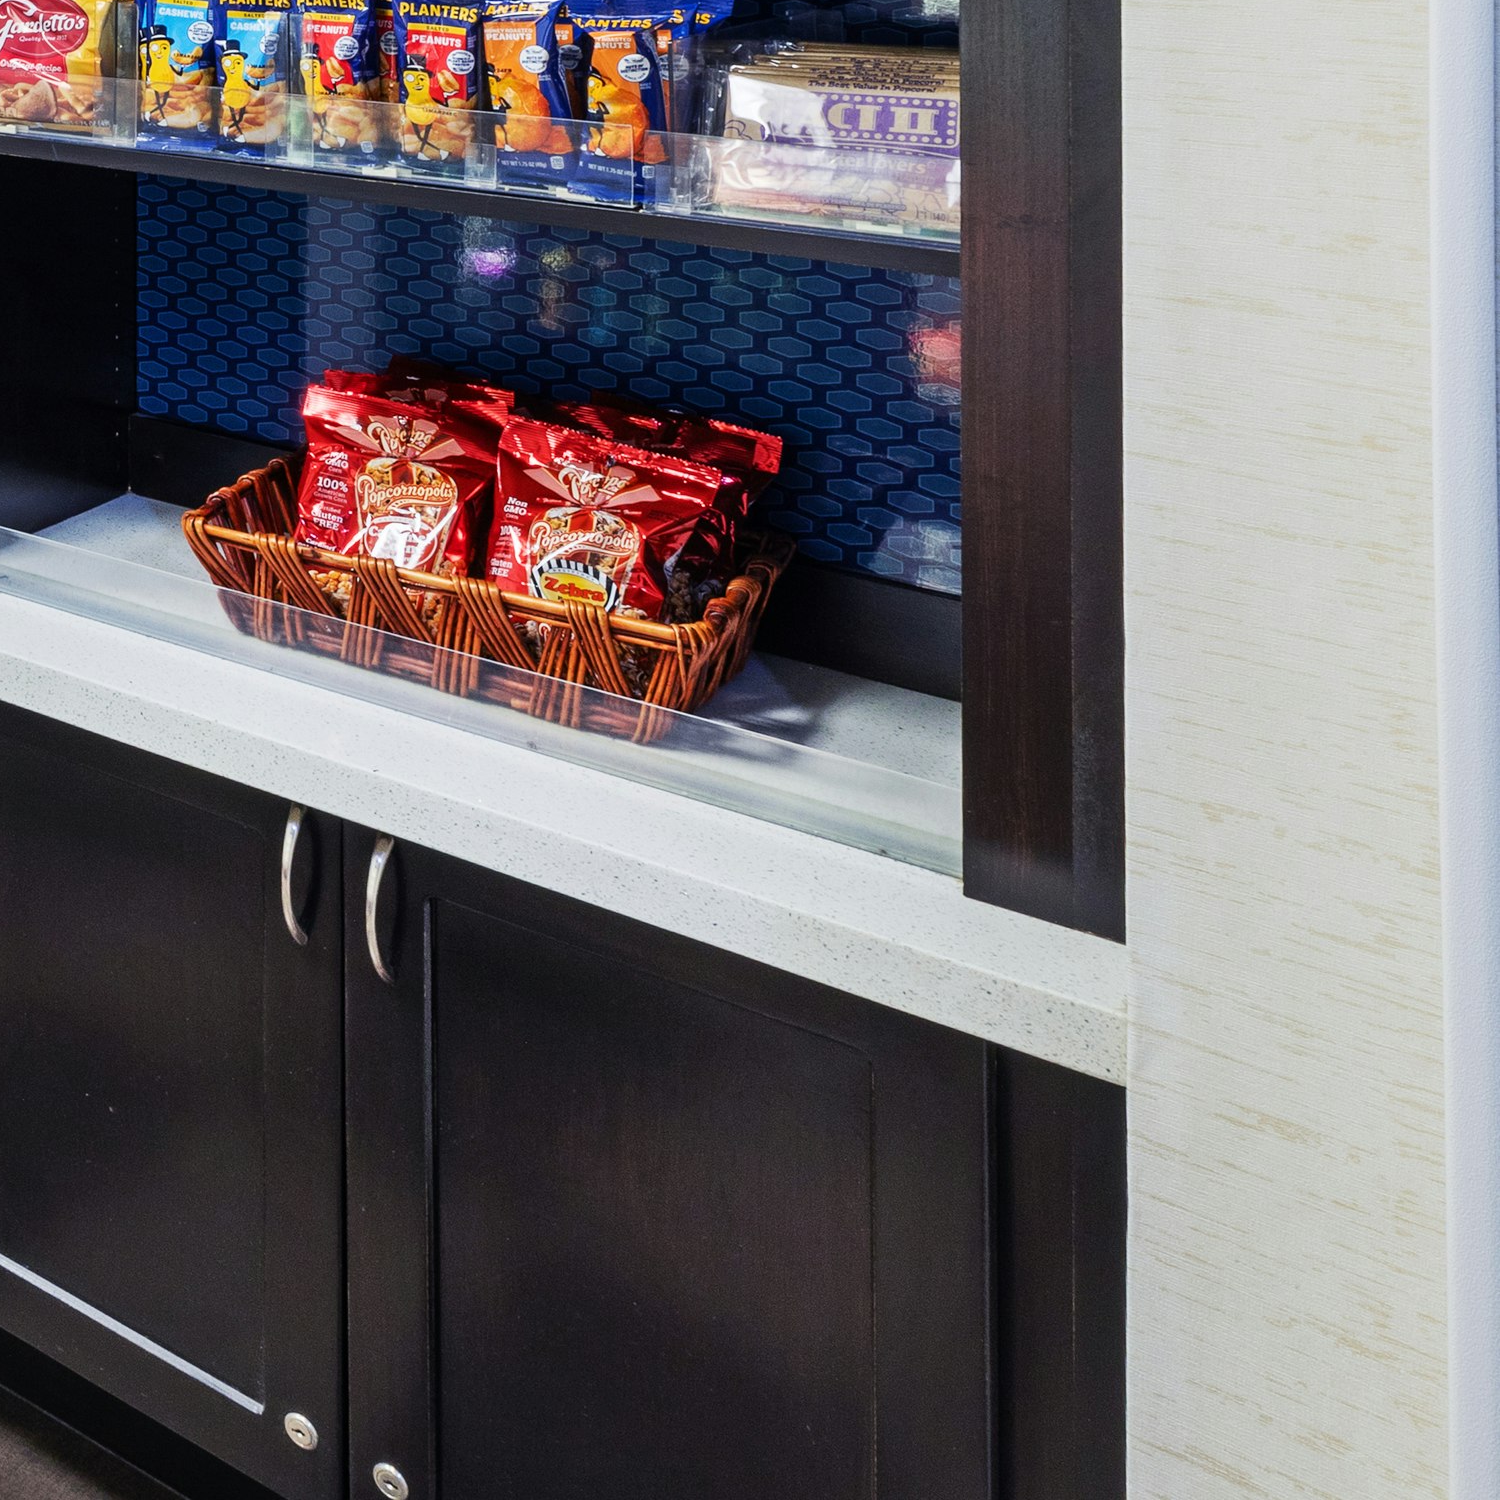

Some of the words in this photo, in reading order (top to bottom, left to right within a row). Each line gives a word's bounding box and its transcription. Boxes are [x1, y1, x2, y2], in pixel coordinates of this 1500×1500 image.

[158, 7, 205, 20] CASHEWS
[399, 1, 478, 24] PLANTERS
[306, 24, 349, 35] PEANUTS
[504, 27, 533, 35] ROASTED
[411, 34, 462, 48] PEANUTS
[486, 33, 532, 42] PEANUTS
[35, 63, 63, 73] Recipe
[893, 85, 937, 93] Popcorn!
[889, 105, 940, 136] II
[317, 476, 348, 492] 100%
[317, 487, 346, 498] American
[357, 474, 454, 511] Popcornopolis
[507, 496, 528, 508] Non
[310, 508, 344, 523] Gluten
[503, 504, 527, 516] GMO
[313, 517, 340, 532] FREE
[532, 520, 636, 553] Popcornopolis
[544, 575, 605, 601] Zebra
